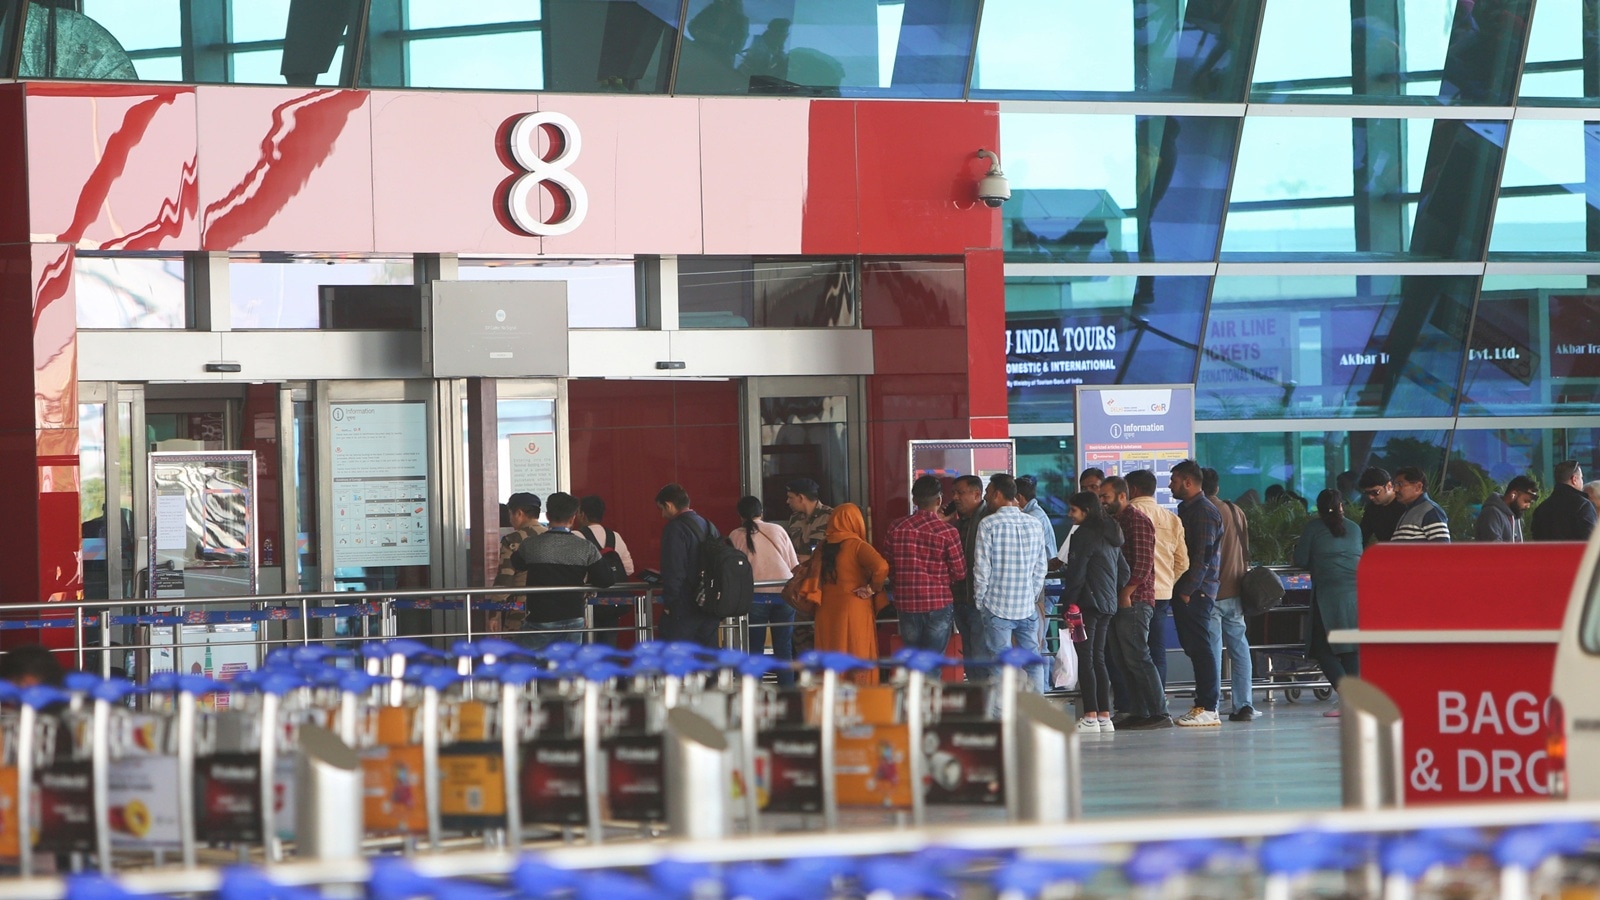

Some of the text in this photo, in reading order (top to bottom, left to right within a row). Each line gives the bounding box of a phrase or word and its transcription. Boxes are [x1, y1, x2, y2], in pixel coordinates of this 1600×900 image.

[508, 111, 588, 236] 8
[1212, 318, 1276, 338] AIR LINE
[1015, 328, 1060, 354] INDIA
[1063, 326, 1116, 352] TOURS
[1555, 343, 1586, 355] Akbar
[1043, 361, 1049, 372] &
[1050, 360, 1116, 372] INTERNATIONAL
[1339, 353, 1378, 366] Akbar
[1469, 348, 1493, 361] Pvt.
[1495, 346, 1521, 360] Ltd.
[345, 407, 376, 415] Information
[1123, 423, 1164, 432] Information
[1438, 691, 1549, 736] BAG
[1411, 748, 1442, 791] &
